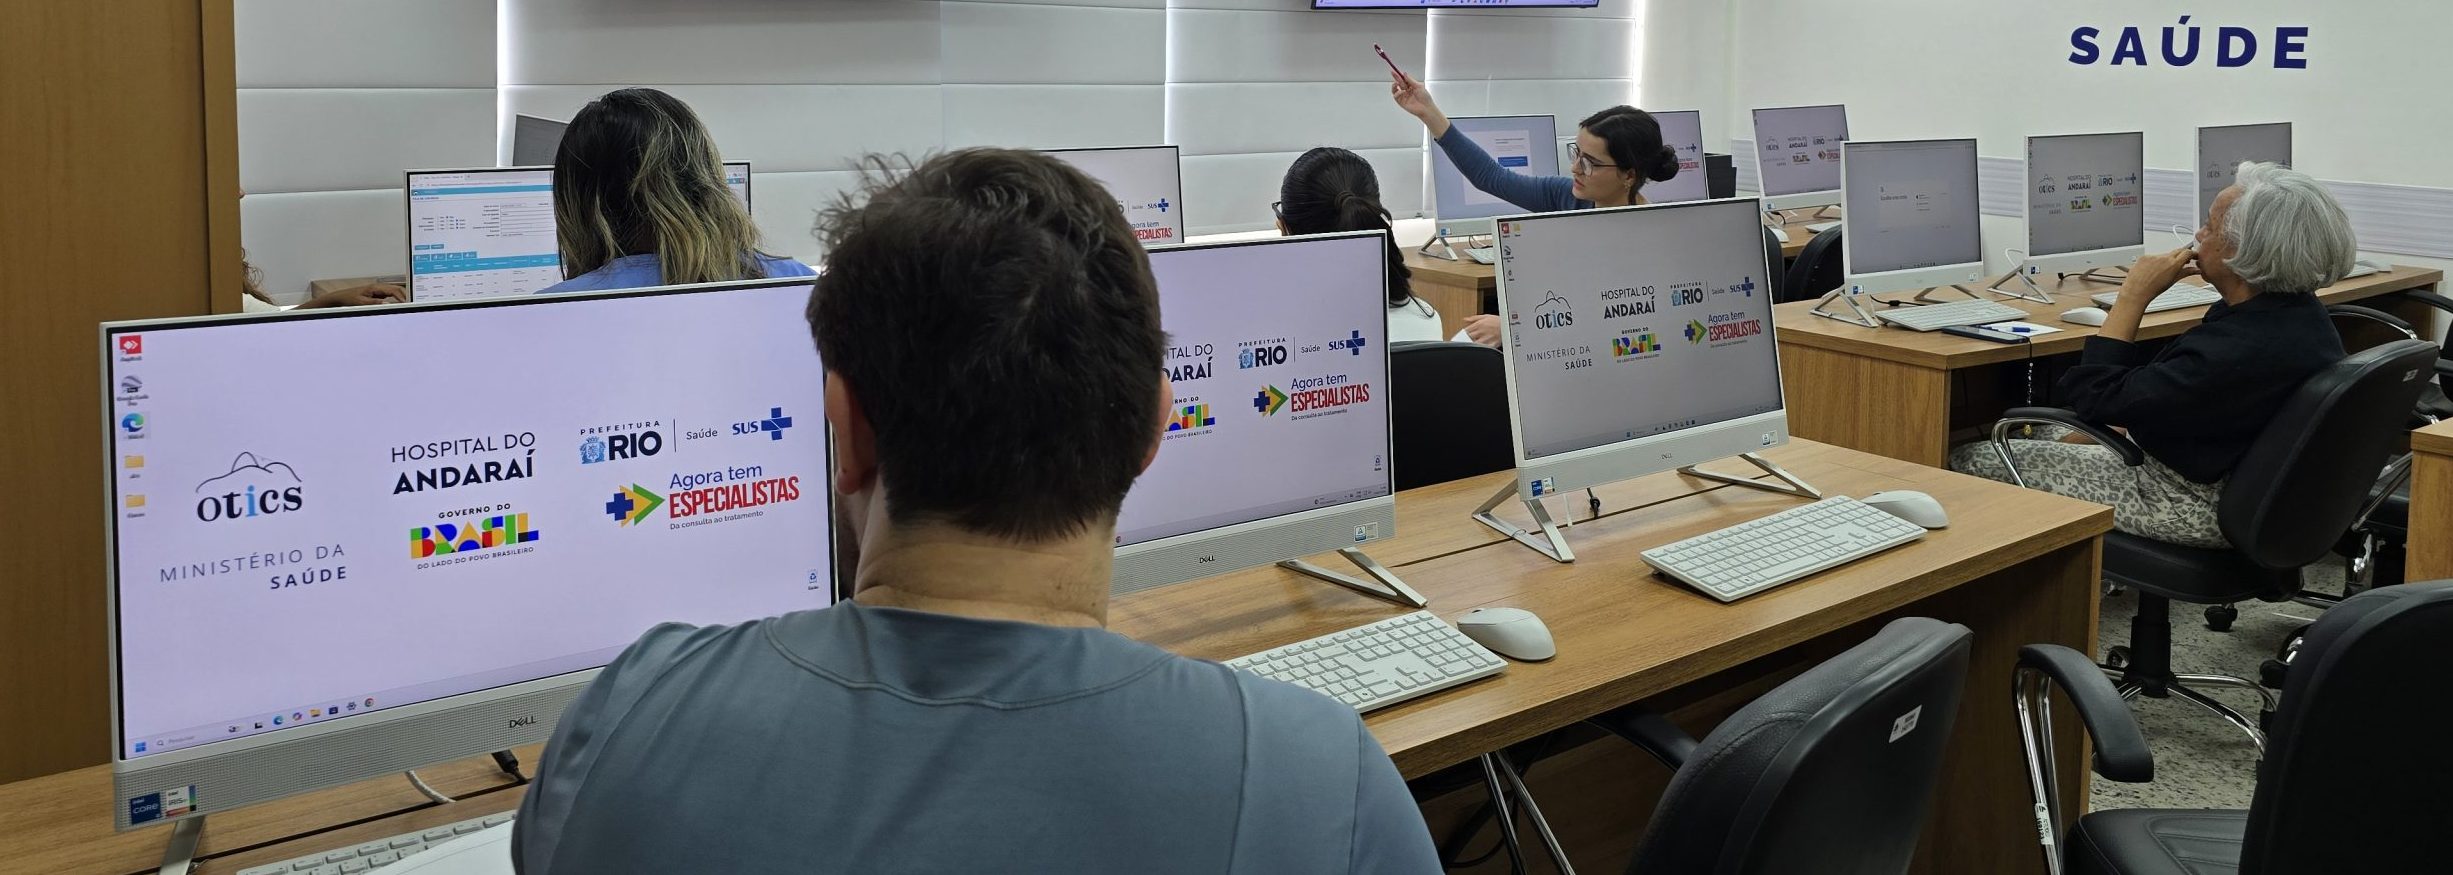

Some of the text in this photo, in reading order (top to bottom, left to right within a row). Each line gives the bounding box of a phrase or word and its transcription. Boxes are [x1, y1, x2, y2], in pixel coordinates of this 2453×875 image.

[2067, 15, 2309, 69] SAÚDE
[1130, 222, 1146, 230] gora
[1134, 228, 1172, 239] PECIALISTAS
[1601, 285, 1655, 301] HOSPITAL DO
[1681, 288, 1703, 305] RIO
[1729, 284, 1741, 293] SUS
[1604, 296, 1655, 319] ANDARAÍ
[1536, 310, 1573, 330] otics
[1708, 311, 1745, 325] Agora tem
[1708, 319, 1761, 341] ESPECIALISTAS
[1238, 337, 1286, 347] PREFEITURA
[1300, 345, 1321, 354] Saúde
[1328, 339, 1345, 351] SUS
[1166, 343, 1213, 360] ITAL DO
[1255, 345, 1287, 367] RIO
[1526, 345, 1591, 362] MINISTÉRIO DA
[1565, 358, 1592, 370] SAÚDE
[1291, 374, 1347, 391] Agora tem
[1290, 383, 1370, 412] ESPECIALISTAS
[1165, 403, 1216, 432] ASIL
[580, 420, 660, 436] PREFEITURA
[686, 429, 718, 440] Saúde
[732, 421, 759, 436] SUS
[392, 432, 536, 463] HOSPITAL DO
[608, 430, 663, 461] RIO
[393, 448, 535, 495] ANDARAÍ
[669, 465, 762, 490] Agora tem
[196, 485, 303, 522] otics
[669, 475, 800, 519] ESPECIALISTAS
[438, 503, 511, 519] GOVERNO DO
[681, 518, 713, 528] consulta
[724, 510, 764, 522] tratamento
[410, 512, 540, 560] BRASIL
[159, 543, 345, 583] MINISTÉRIO DA
[432, 559, 452, 568] LADO
[469, 553, 490, 562] POVO
[492, 546, 534, 558] BRASILEIRO
[270, 565, 348, 590] SAÚDE
[509, 715, 537, 728] DELL
